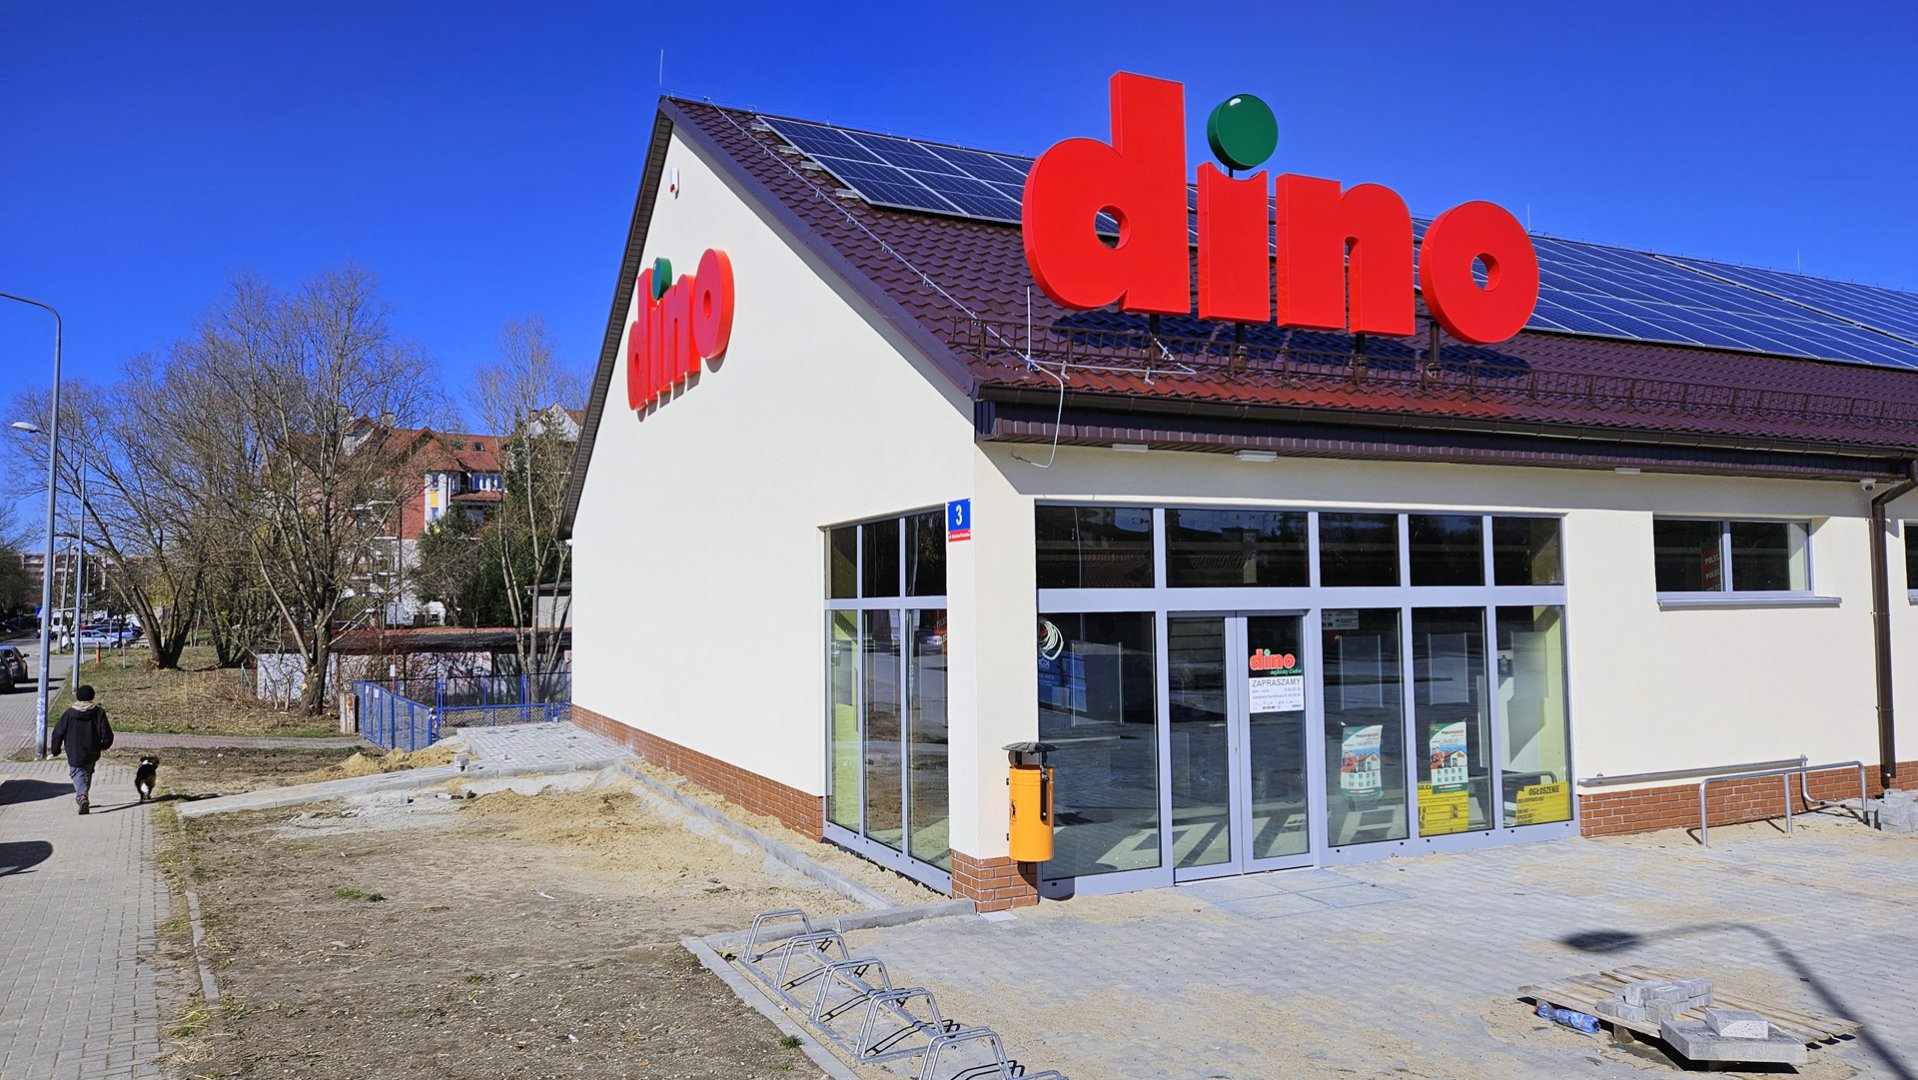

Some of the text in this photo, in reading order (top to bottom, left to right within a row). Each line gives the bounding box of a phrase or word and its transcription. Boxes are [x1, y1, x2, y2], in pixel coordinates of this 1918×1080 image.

[1022, 71, 1539, 343] dino
[627, 248, 734, 411] dino
[955, 504, 963, 526] 3
[1250, 648, 1295, 670] dino
[1252, 678, 1301, 687] ZAPRASZAMY
[1529, 785, 1560, 796] OGŁOSZENIE
